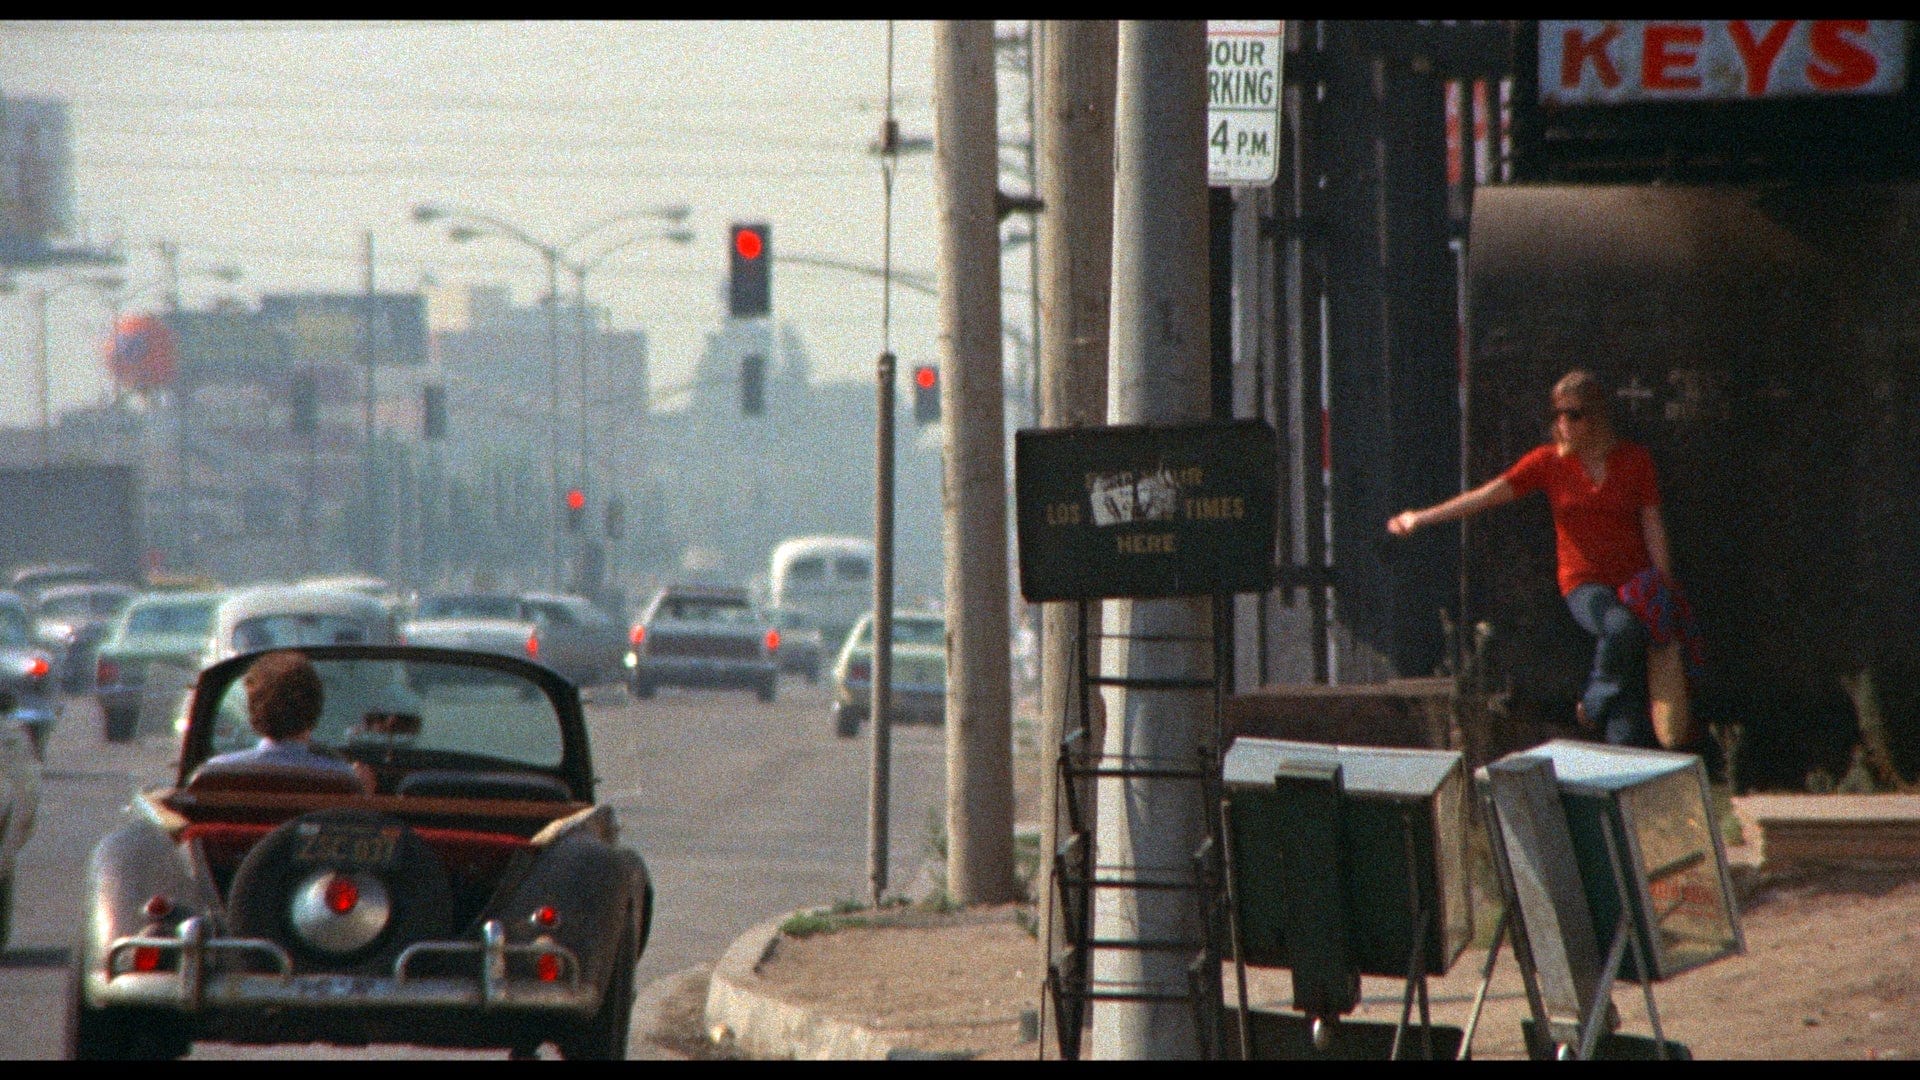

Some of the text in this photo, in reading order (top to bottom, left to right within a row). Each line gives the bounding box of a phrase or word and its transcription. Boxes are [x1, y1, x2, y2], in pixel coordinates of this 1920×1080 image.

[1560, 20, 1878, 96] KEYS
[1211, 119, 1228, 154] 4
[1047, 503, 1081, 525] LOS
[1185, 497, 1245, 520] TIMES
[1116, 533, 1176, 553] HERE
